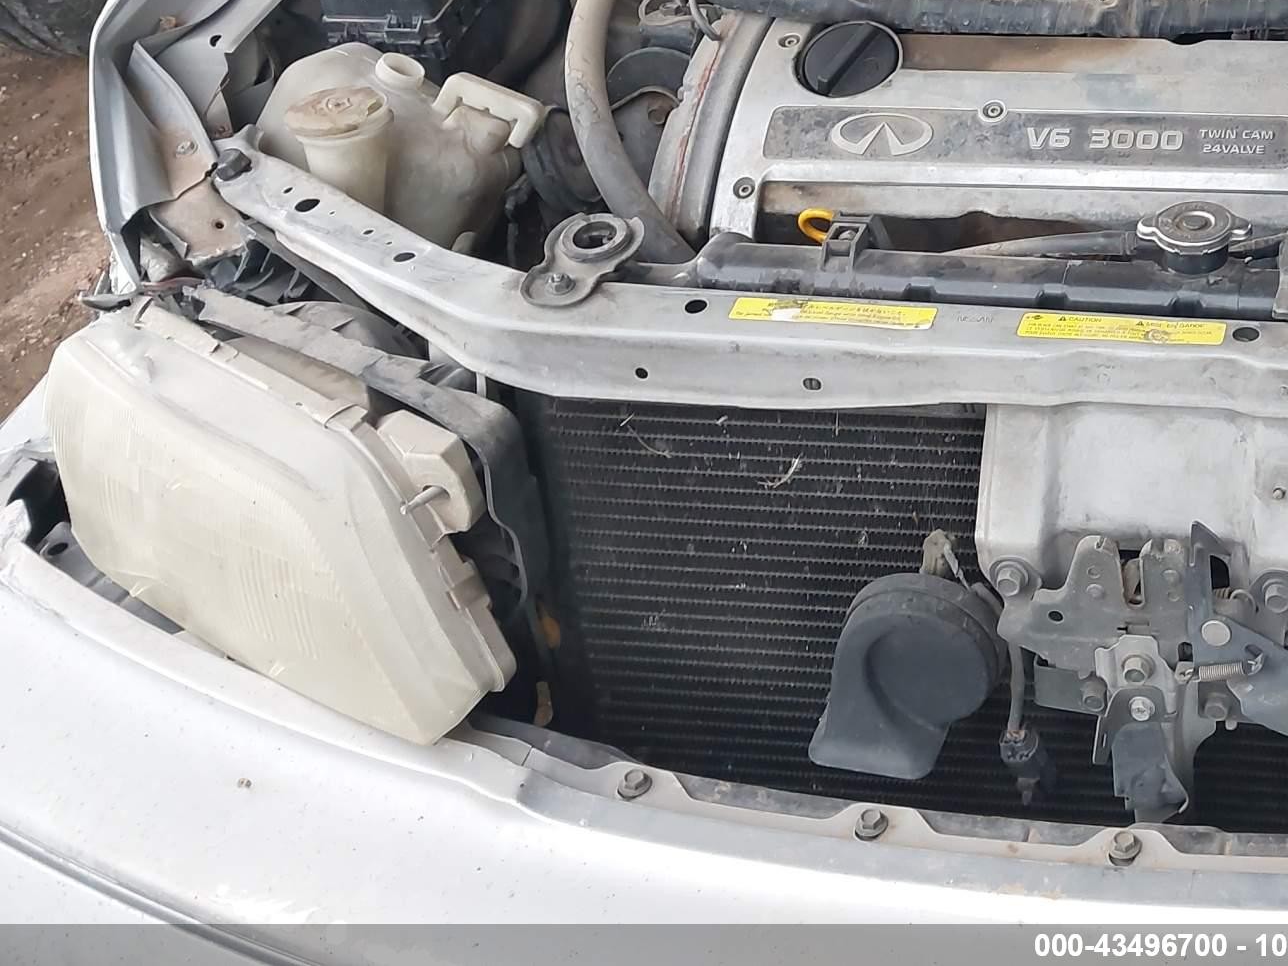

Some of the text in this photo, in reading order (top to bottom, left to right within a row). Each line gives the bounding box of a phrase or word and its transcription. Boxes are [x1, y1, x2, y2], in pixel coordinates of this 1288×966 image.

[1027, 127, 1184, 151] V6 3000
[1200, 129, 1275, 140] TWIN CAM
[1203, 143, 1265, 154] 24VALVE
[1068, 315, 1102, 323] CAUTION
